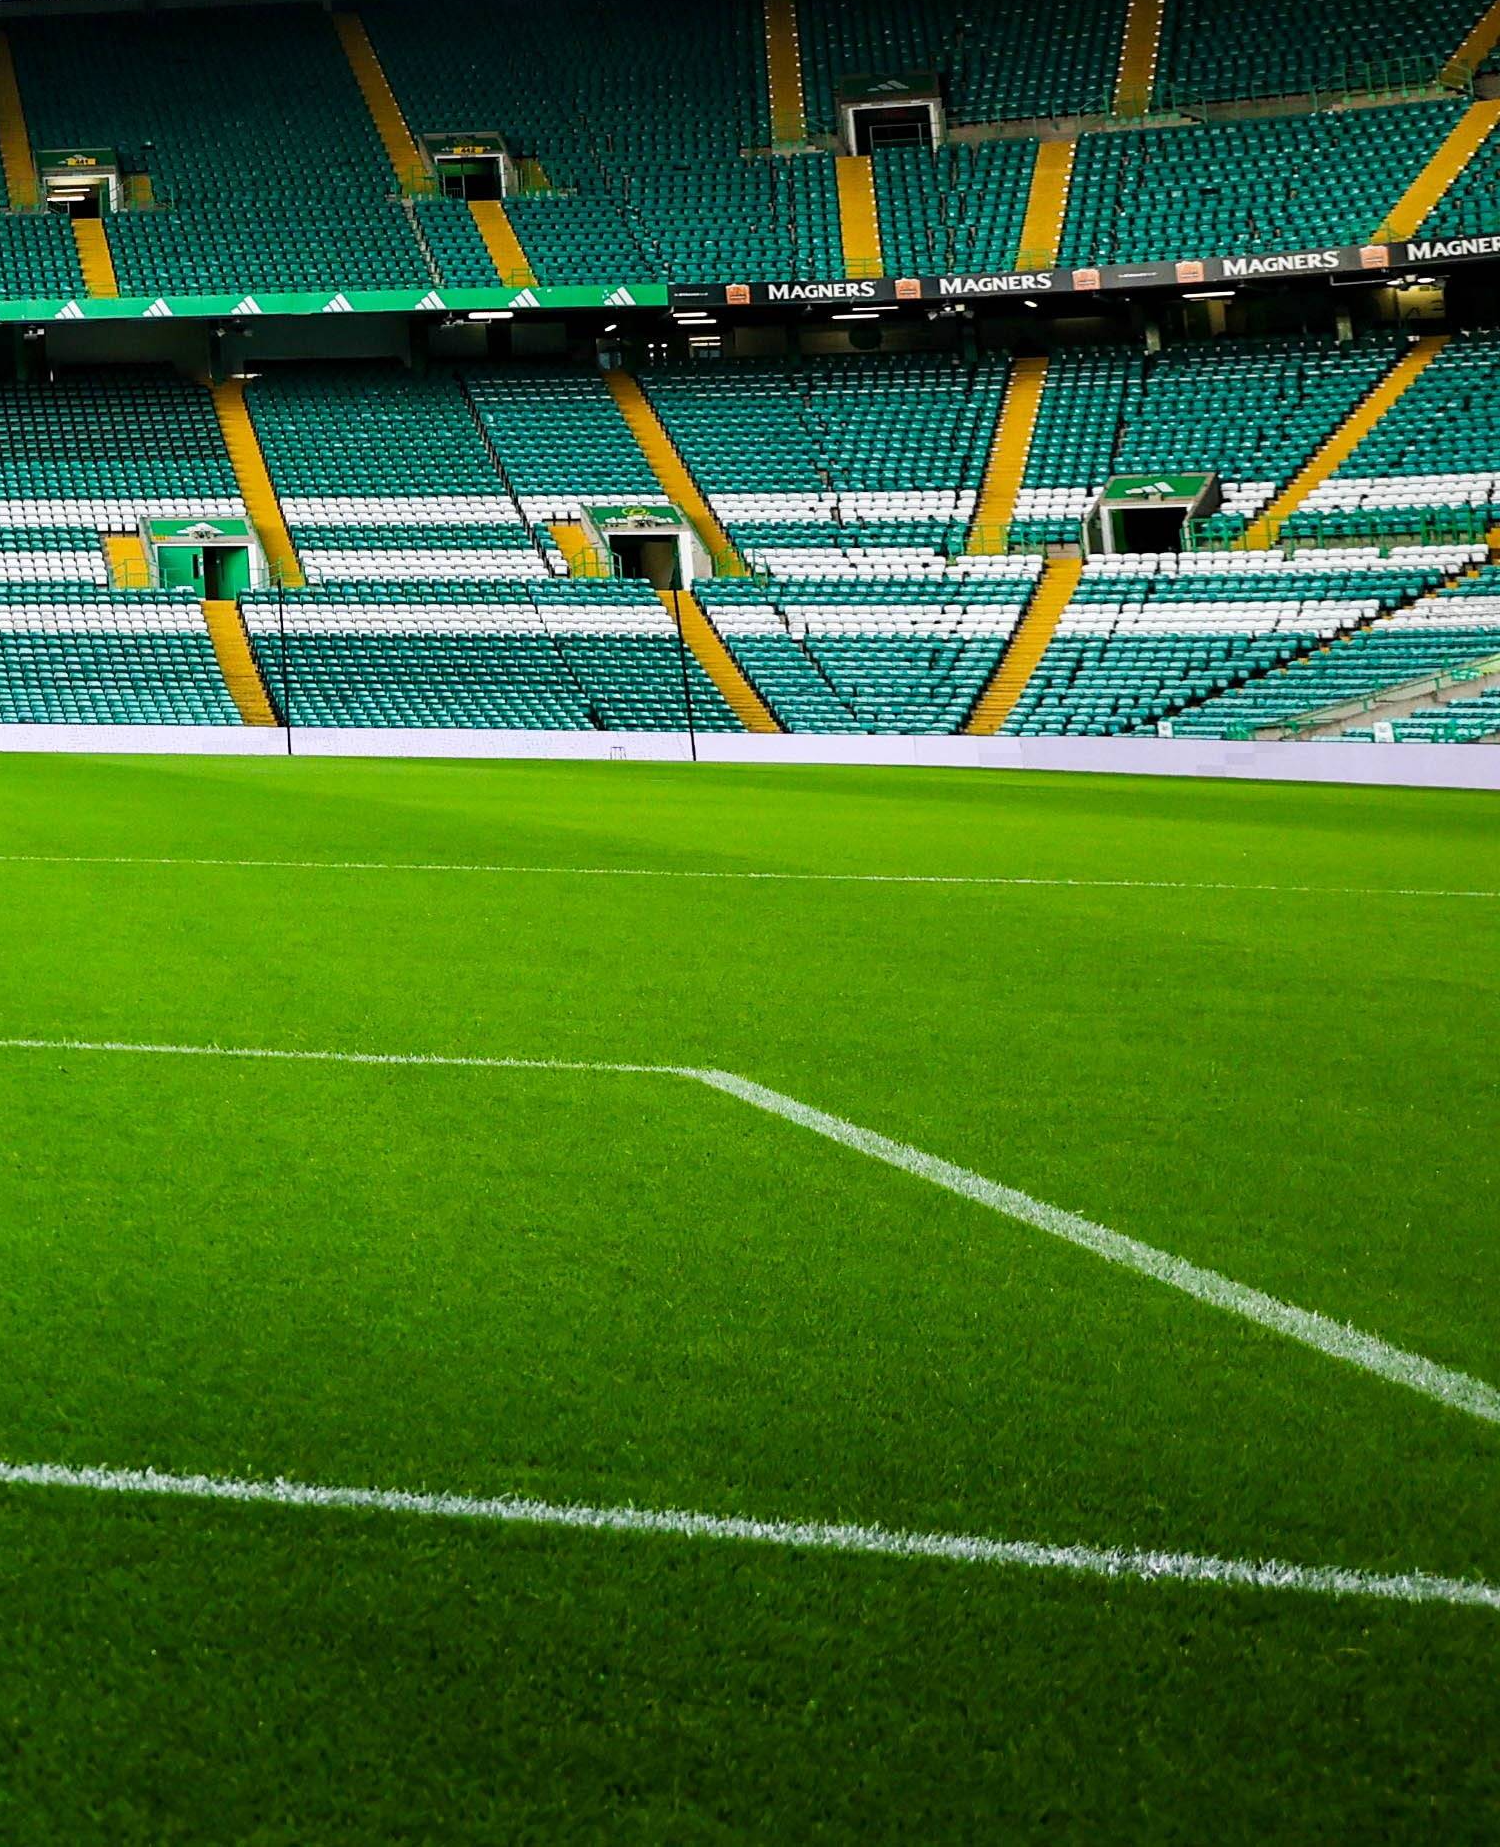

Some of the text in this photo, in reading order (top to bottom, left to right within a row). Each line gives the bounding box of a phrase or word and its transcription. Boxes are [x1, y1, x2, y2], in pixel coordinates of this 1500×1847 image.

[1222, 251, 1339, 277] MAGNERS
[768, 281, 875, 300] MAGNERS
[939, 273, 1052, 295] MAGNERS
